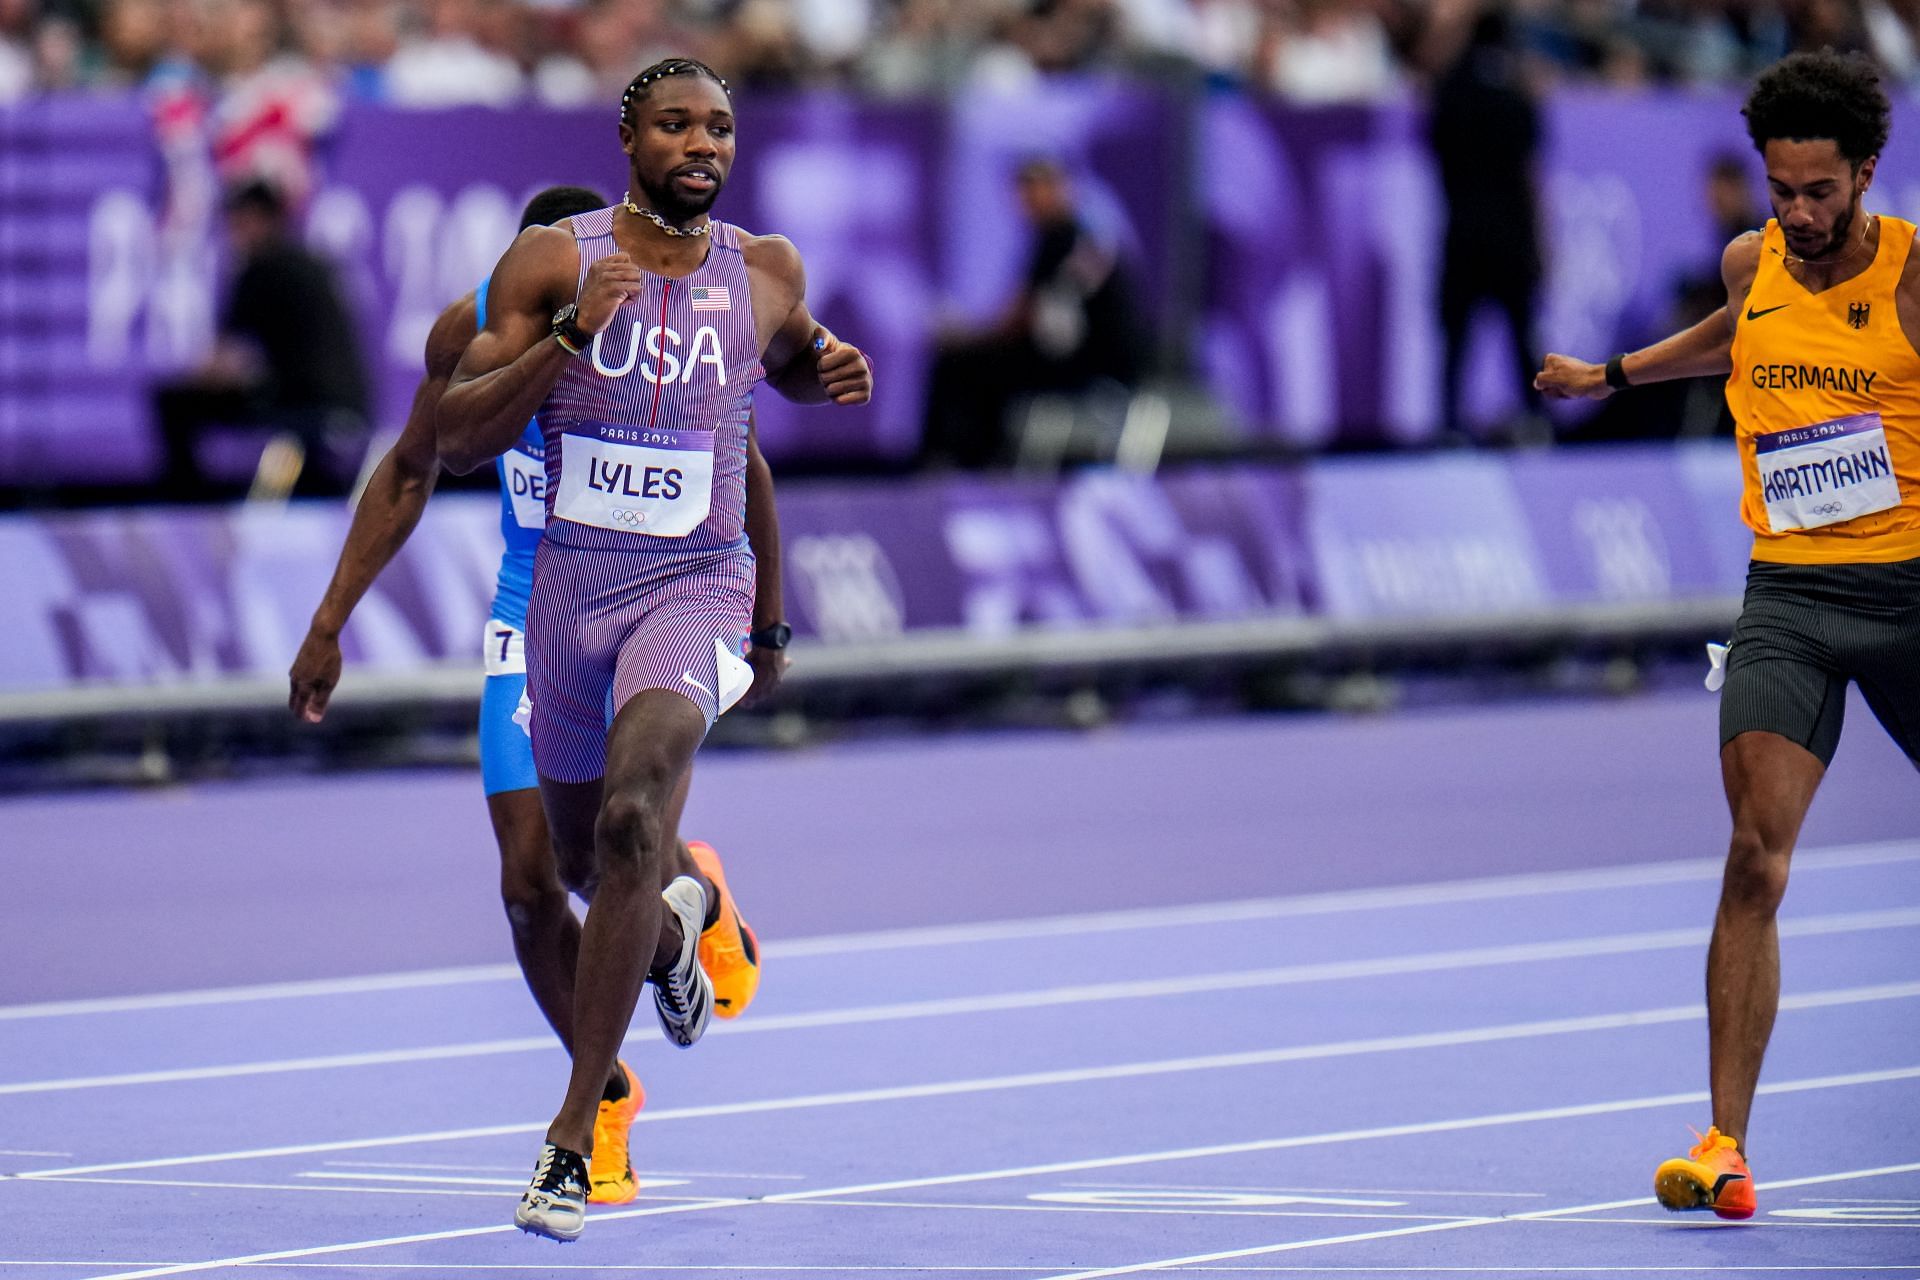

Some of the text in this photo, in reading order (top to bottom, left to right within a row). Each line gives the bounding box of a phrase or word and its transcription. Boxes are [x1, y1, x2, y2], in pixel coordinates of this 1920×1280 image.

[591, 321, 727, 386] USA
[1752, 365, 1877, 393] GERMANY
[600, 427, 678, 445] PARIS 2024
[1778, 424, 1845, 445] PARIS 2024
[588, 457, 683, 500] LYLES
[1762, 446, 1890, 503] HARTMANN
[495, 630, 513, 661] 7
